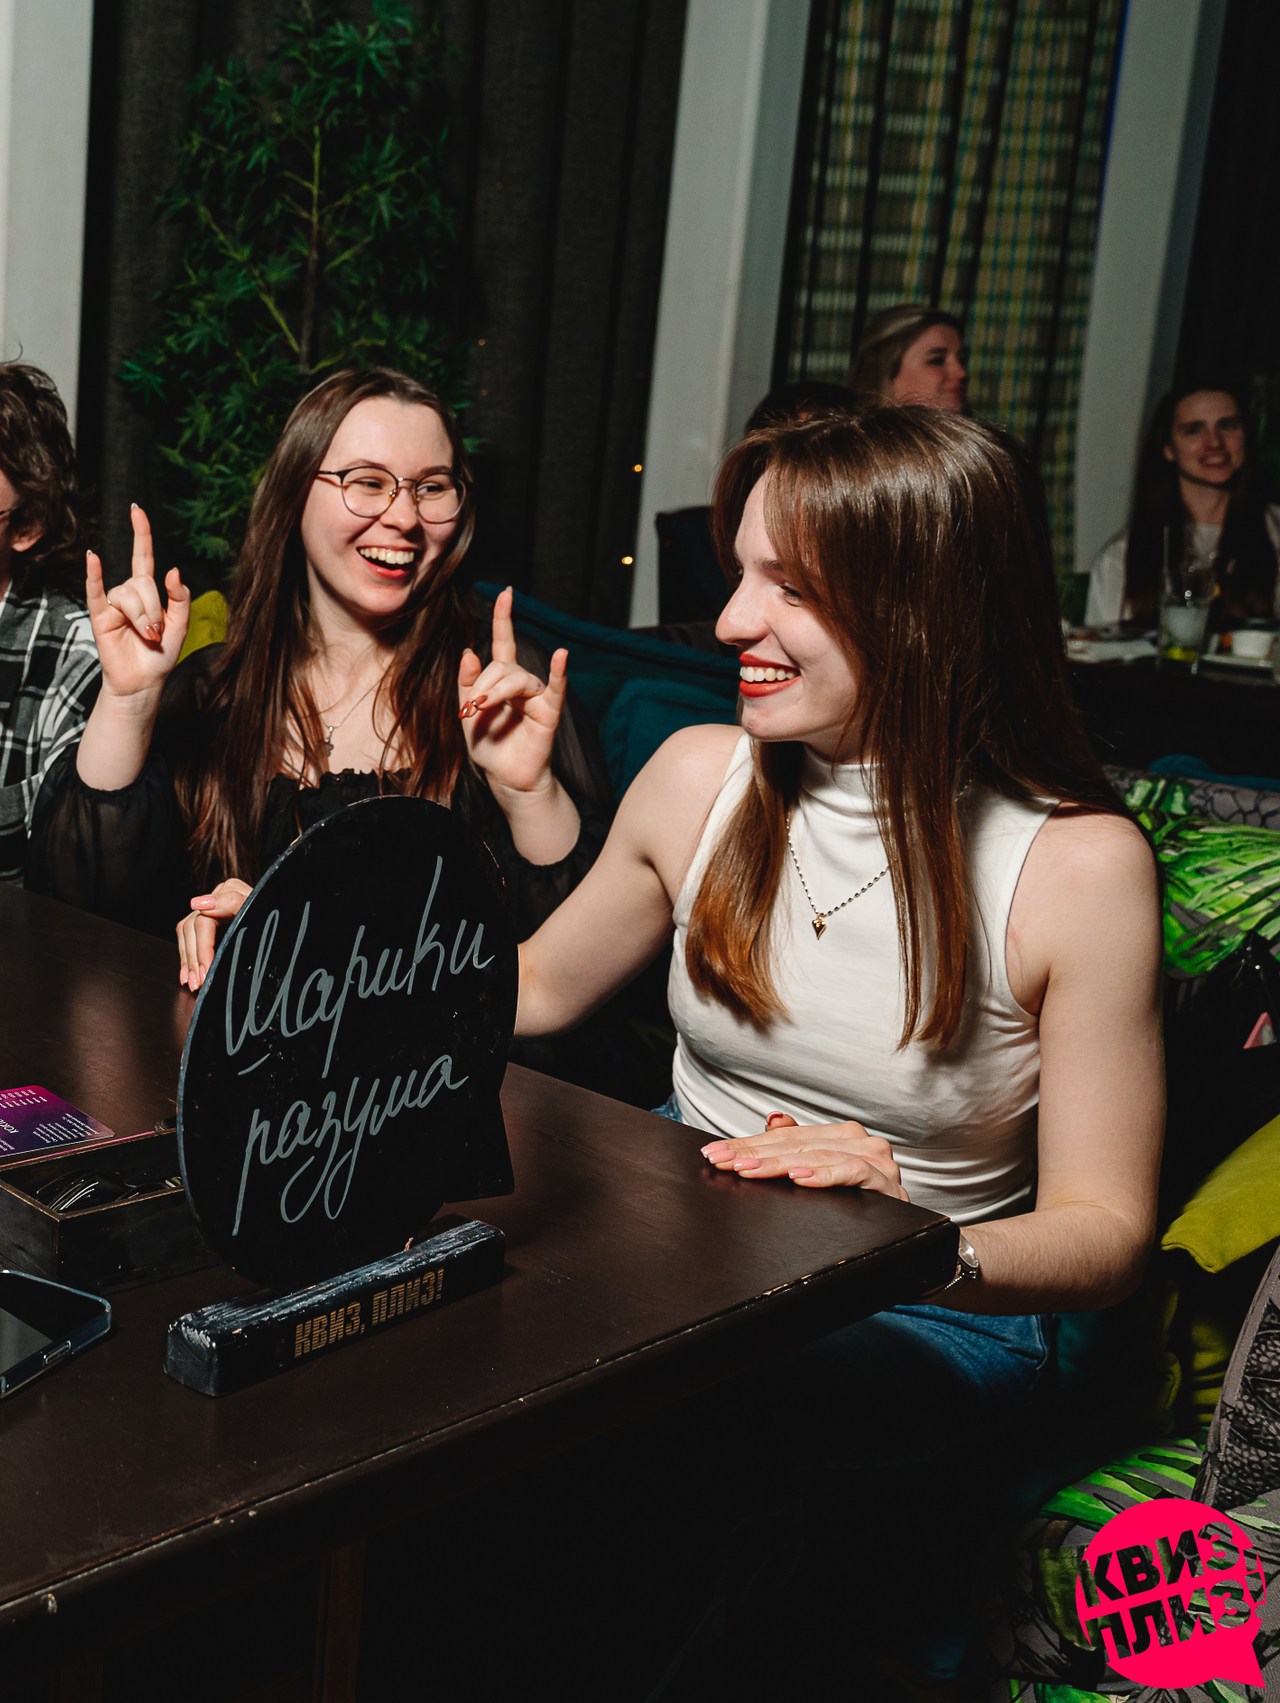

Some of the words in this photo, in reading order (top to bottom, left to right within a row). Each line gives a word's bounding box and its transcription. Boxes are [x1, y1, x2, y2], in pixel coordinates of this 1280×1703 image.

[225, 855, 495, 1078] Шарики
[231, 1054, 469, 1236] разума
[294, 1301, 366, 1359] КВИЗ,
[371, 1267, 445, 1327] ПЛИЗ!
